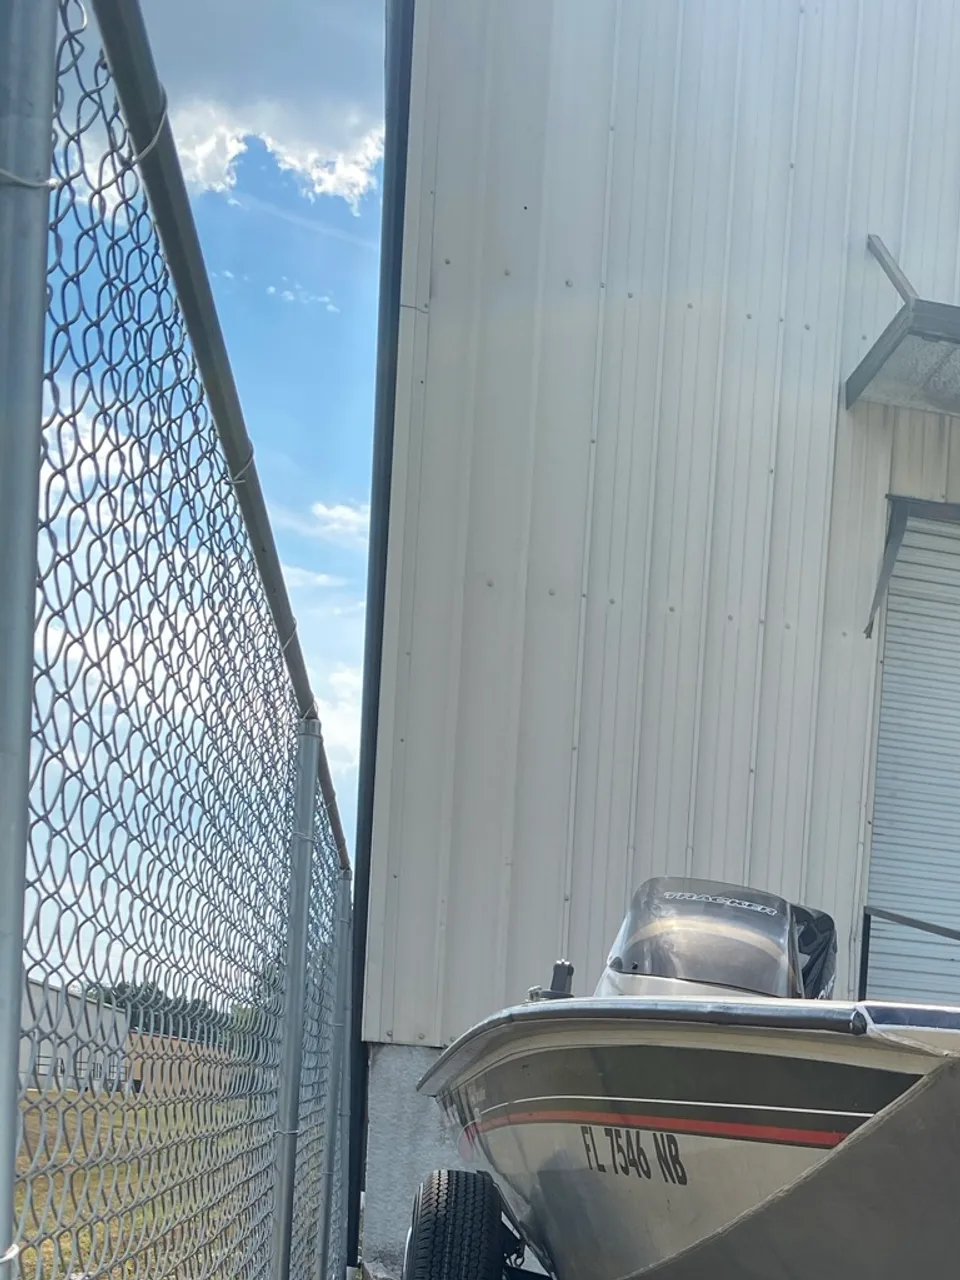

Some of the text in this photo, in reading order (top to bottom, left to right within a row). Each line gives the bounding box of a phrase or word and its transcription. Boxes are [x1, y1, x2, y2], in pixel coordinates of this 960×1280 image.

[663, 891, 778, 916] TRACKER
[580, 1125, 688, 1187] FL 7546 NB
